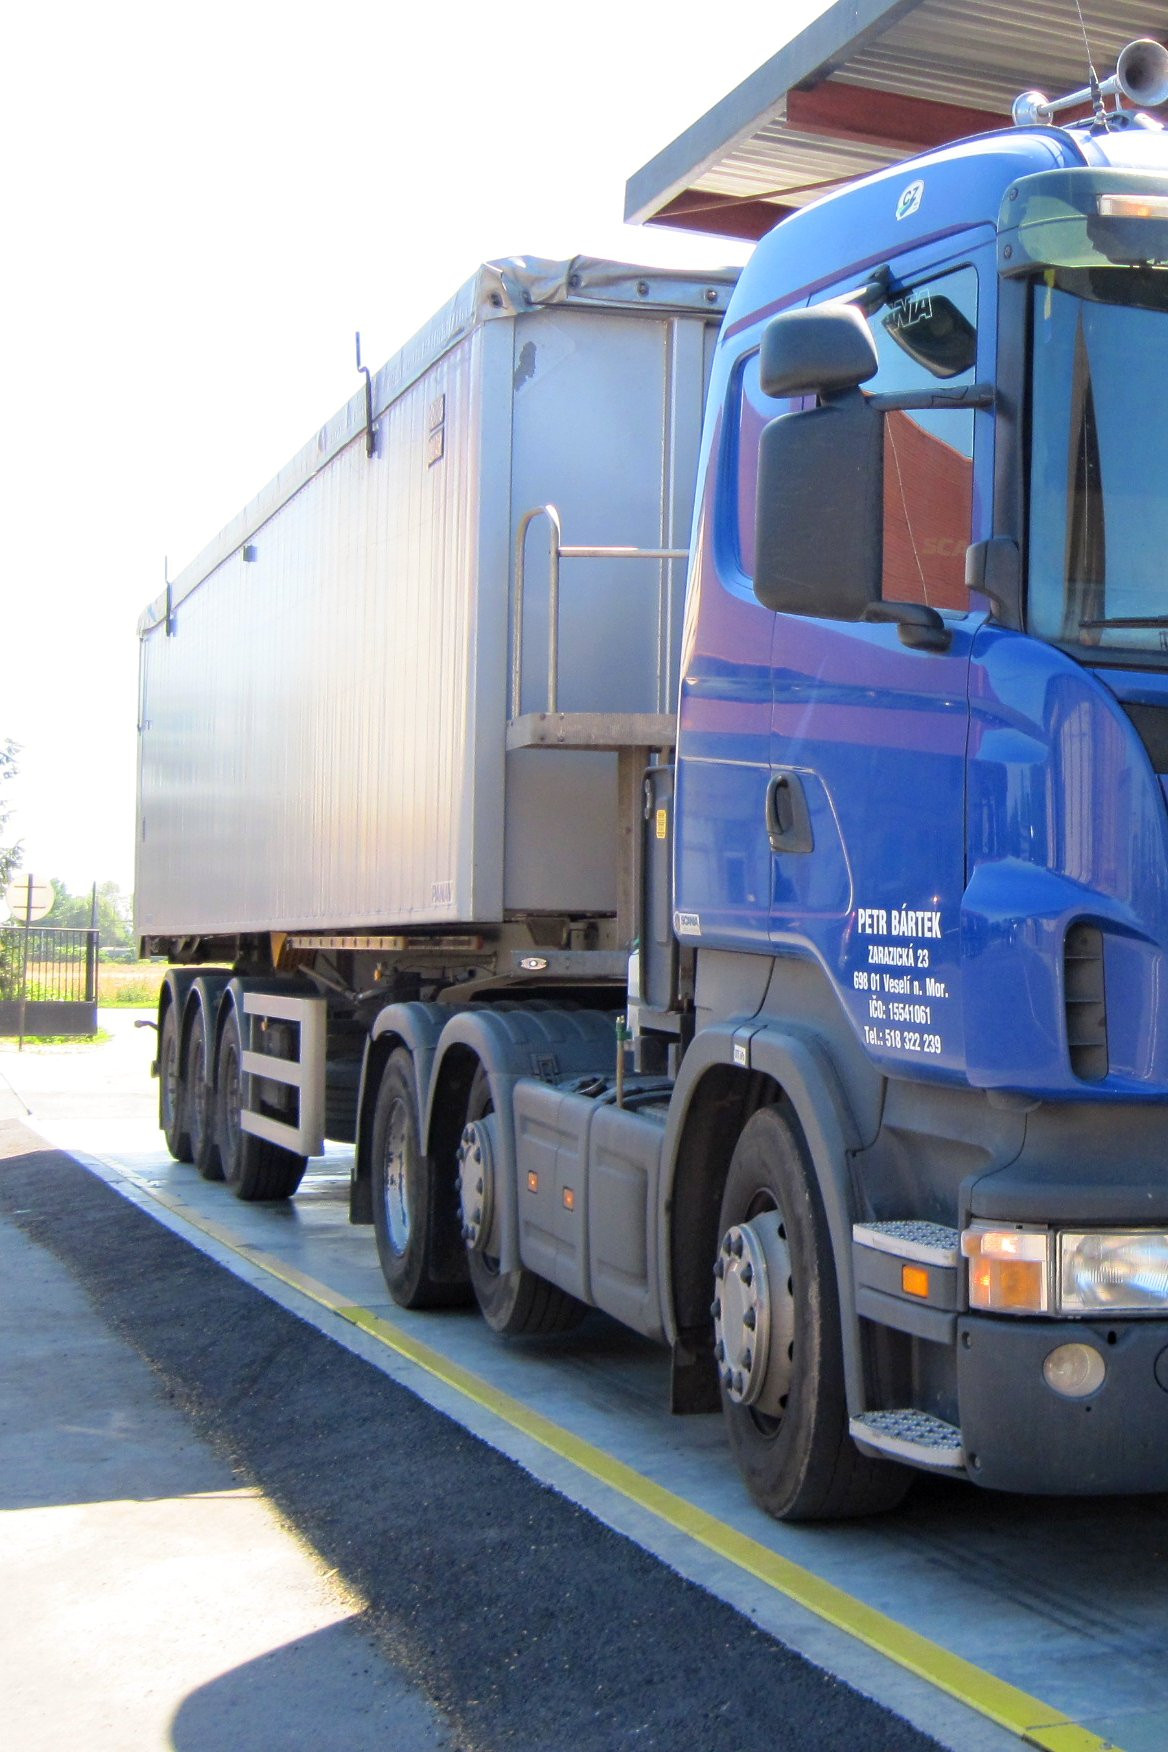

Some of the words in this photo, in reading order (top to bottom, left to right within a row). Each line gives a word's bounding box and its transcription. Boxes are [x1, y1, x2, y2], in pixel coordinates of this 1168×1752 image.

[857, 908, 887, 935] PETR
[891, 903, 942, 939] BÁRTEK
[868, 943, 915, 968] ZARAZICKÁ
[917, 949, 929, 968] 23
[853, 971, 869, 991] 698
[870, 973, 880, 992] 01
[883, 974, 911, 994] Veselí
[913, 980, 923, 996] n.
[926, 978, 949, 998] Mor.
[869, 995, 886, 1018] IČO:
[888, 1003, 931, 1025] 15541061
[864, 1026, 883, 1046] Tel.:
[885, 1029, 901, 1049] 518
[903, 1031, 921, 1051] 322
[923, 1034, 942, 1054] 239
